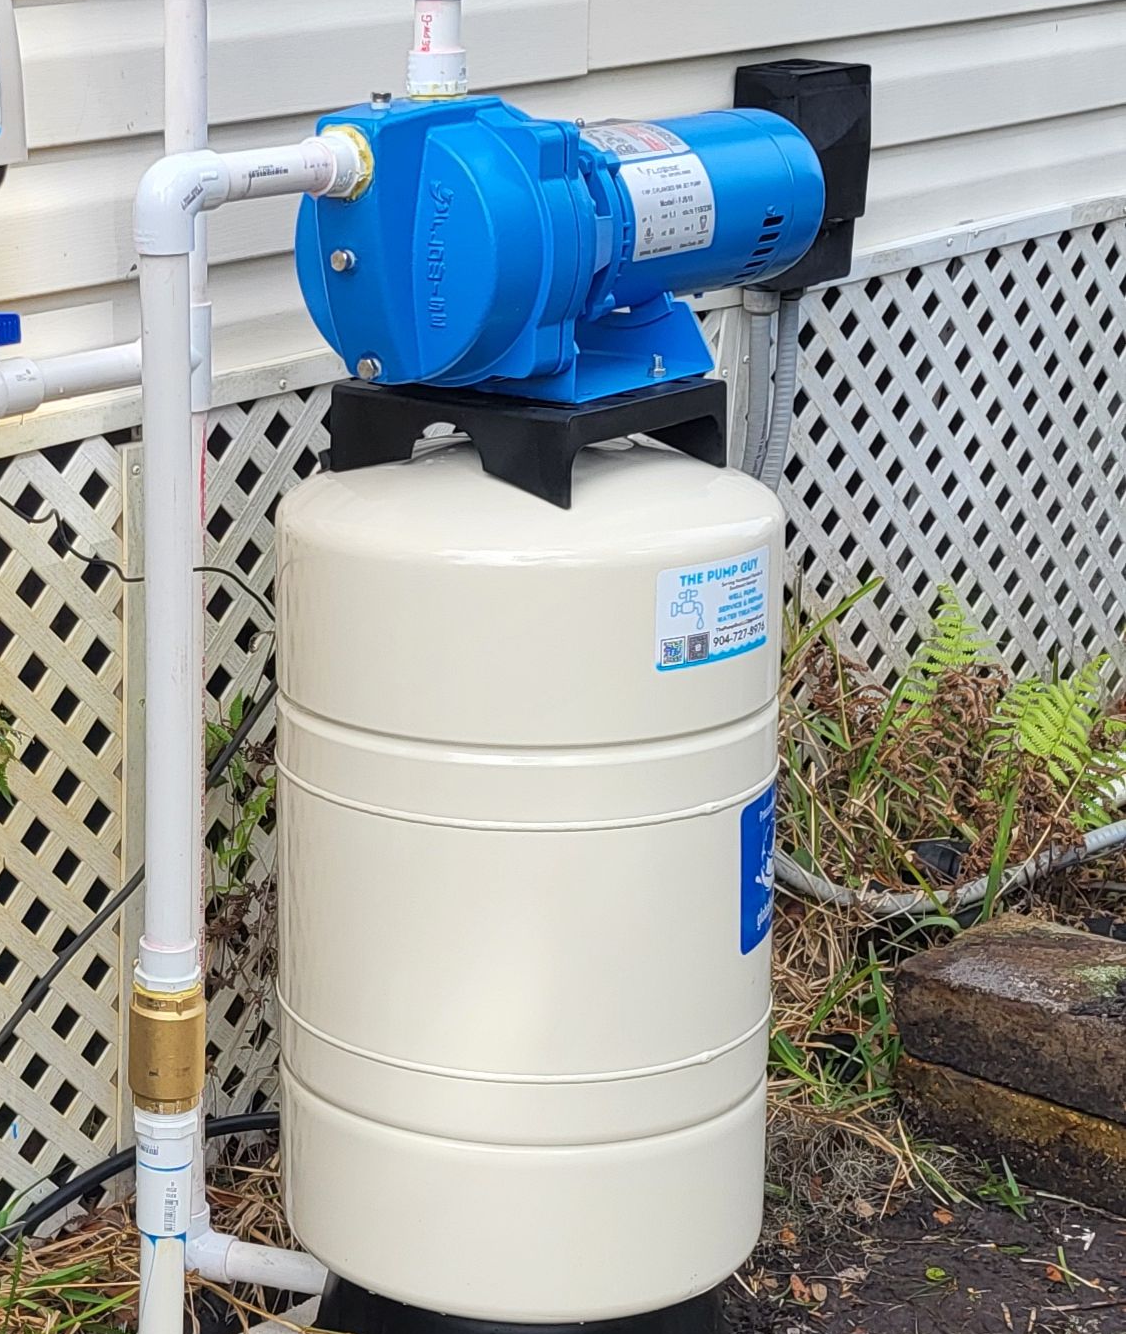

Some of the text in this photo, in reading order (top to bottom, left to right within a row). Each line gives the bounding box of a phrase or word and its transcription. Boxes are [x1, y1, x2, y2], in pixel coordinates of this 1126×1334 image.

[680, 572, 704, 587] THE
[707, 564, 738, 582] PUMP
[740, 556, 758, 573] GUY
[718, 601, 742, 613] SERVICE
